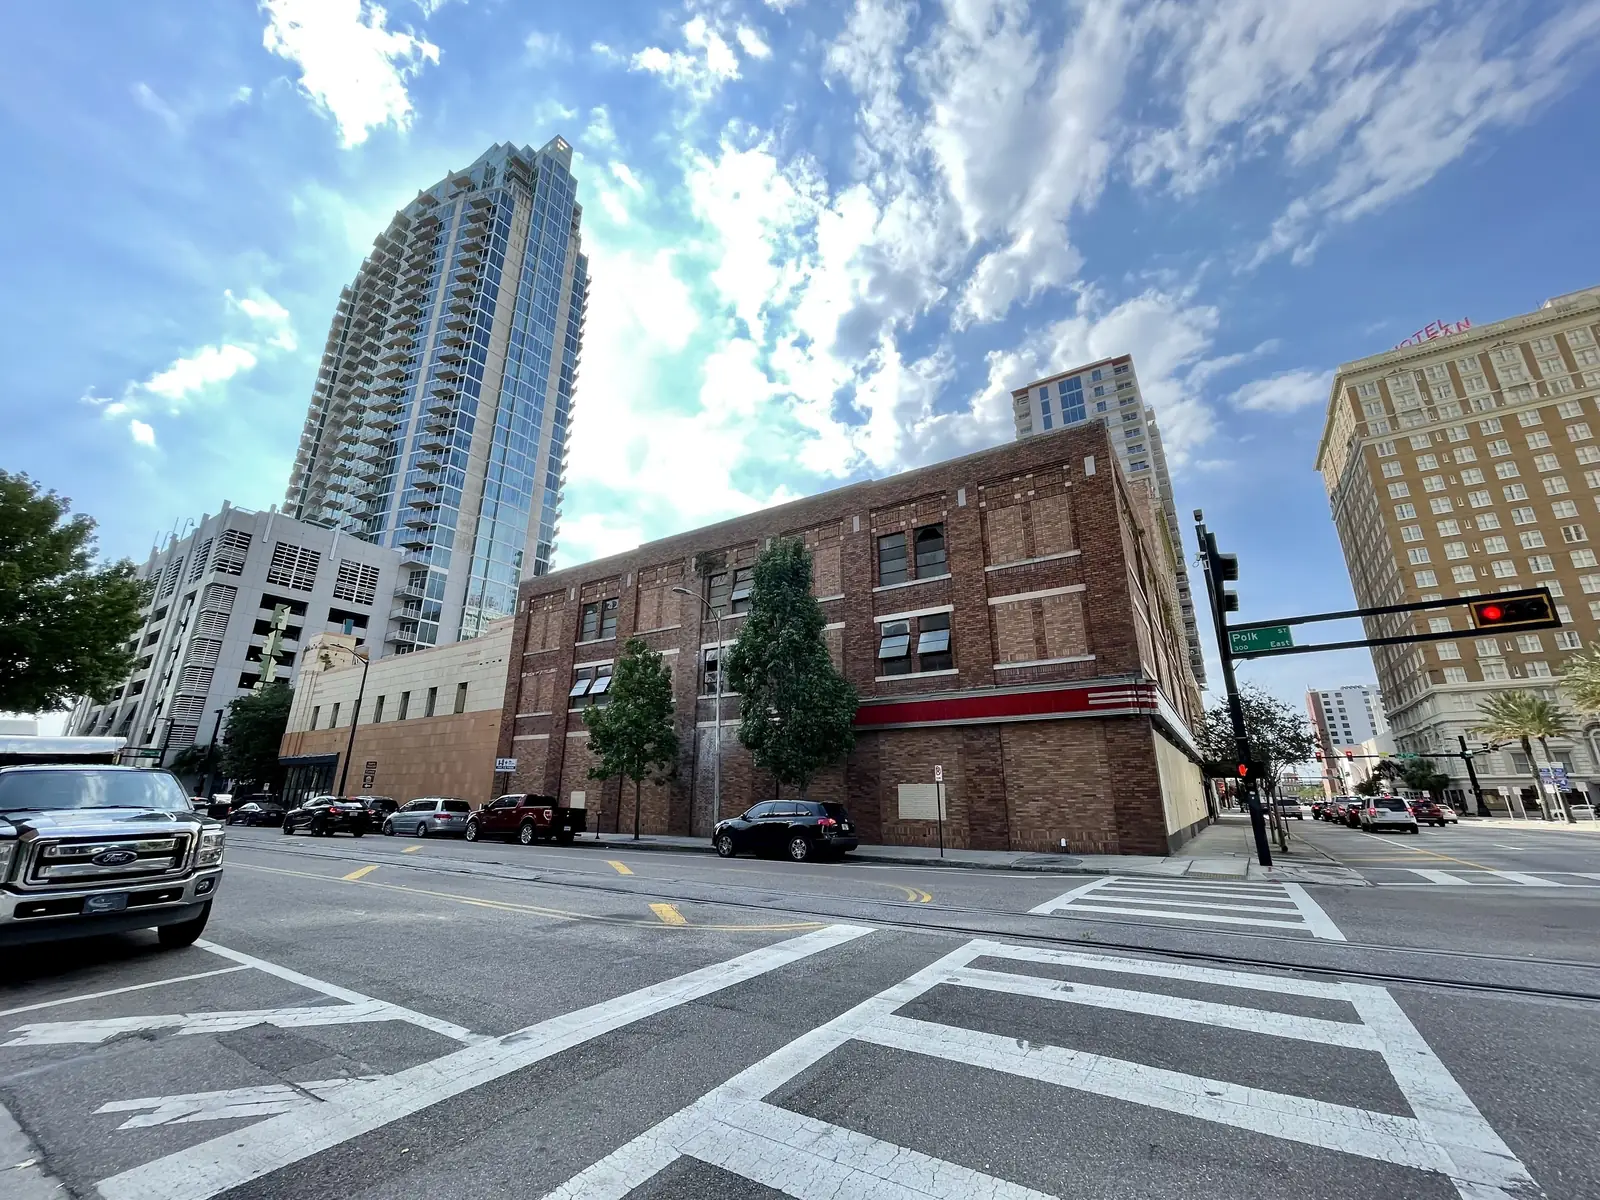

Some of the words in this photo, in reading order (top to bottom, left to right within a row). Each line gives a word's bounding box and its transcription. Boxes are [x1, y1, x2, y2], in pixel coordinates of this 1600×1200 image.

[1393, 318, 1450, 350] OTEL
[1232, 632, 1258, 642] Polk
[1270, 640, 1290, 648] East
[102, 852, 129, 862] Ford
